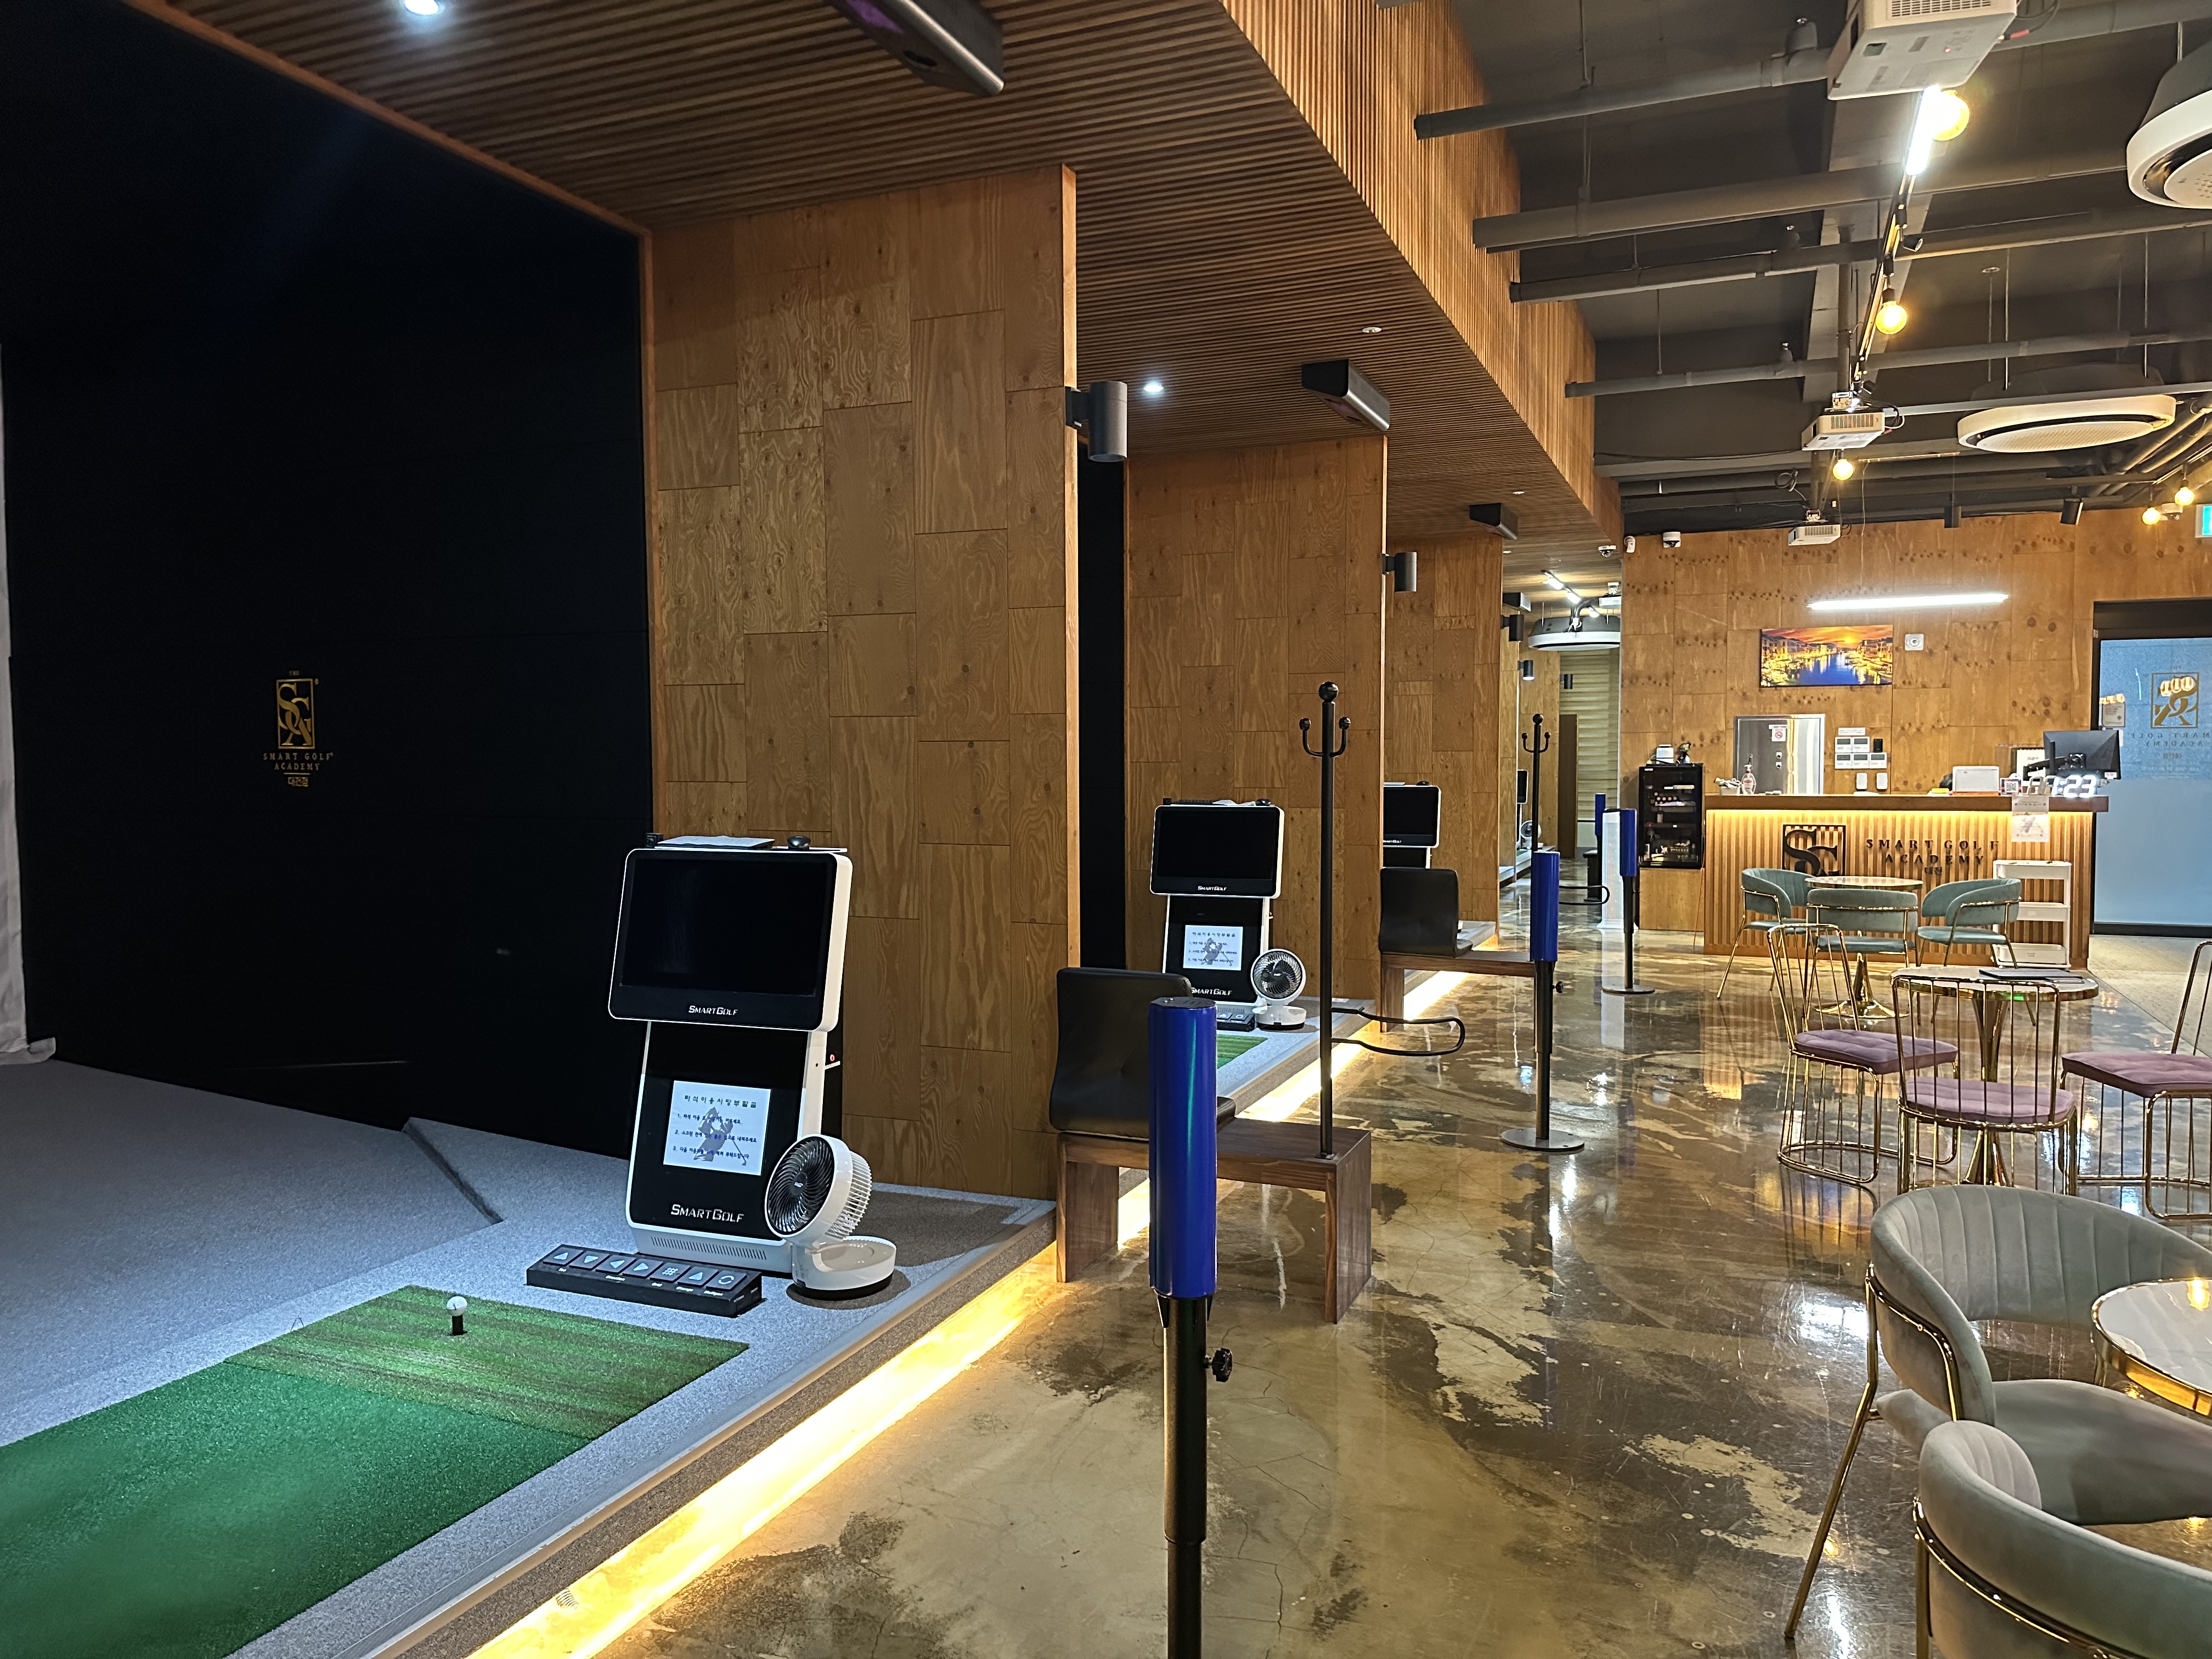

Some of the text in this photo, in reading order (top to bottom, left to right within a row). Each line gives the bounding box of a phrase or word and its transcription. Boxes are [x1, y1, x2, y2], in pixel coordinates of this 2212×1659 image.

[263, 752, 298, 760] SMART
[274, 762, 320, 770] ACADEMY
[1866, 839, 1999, 850] SMART GOLF
[1884, 854, 1984, 864] ACADEMY
[1924, 866, 1943, 876] 대전
